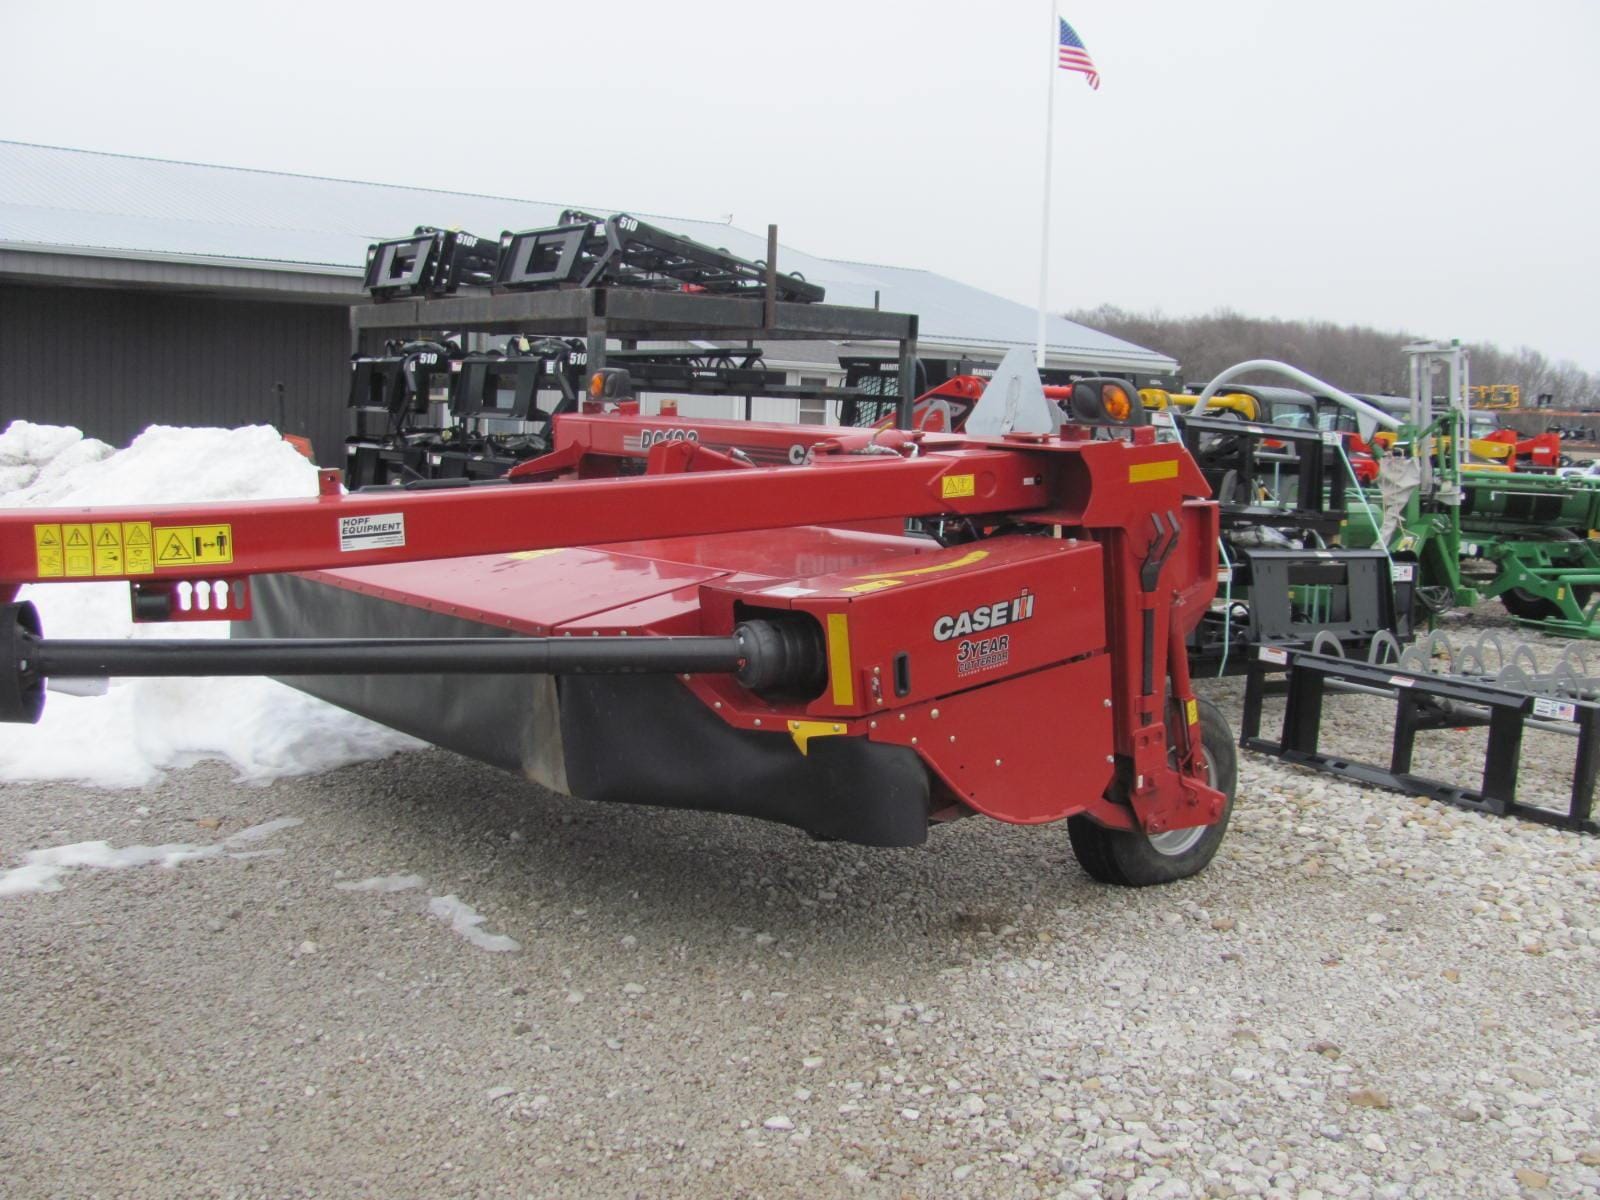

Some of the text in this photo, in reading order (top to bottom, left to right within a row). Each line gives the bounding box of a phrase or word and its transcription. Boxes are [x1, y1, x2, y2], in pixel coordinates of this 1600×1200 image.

[619, 217, 638, 232] 510
[419, 352, 437, 365] 510
[569, 352, 587, 365] 510
[342, 522, 402, 534] EQUIPMENT
[343, 517, 371, 527] HOPF
[933, 601, 1009, 641] CASE
